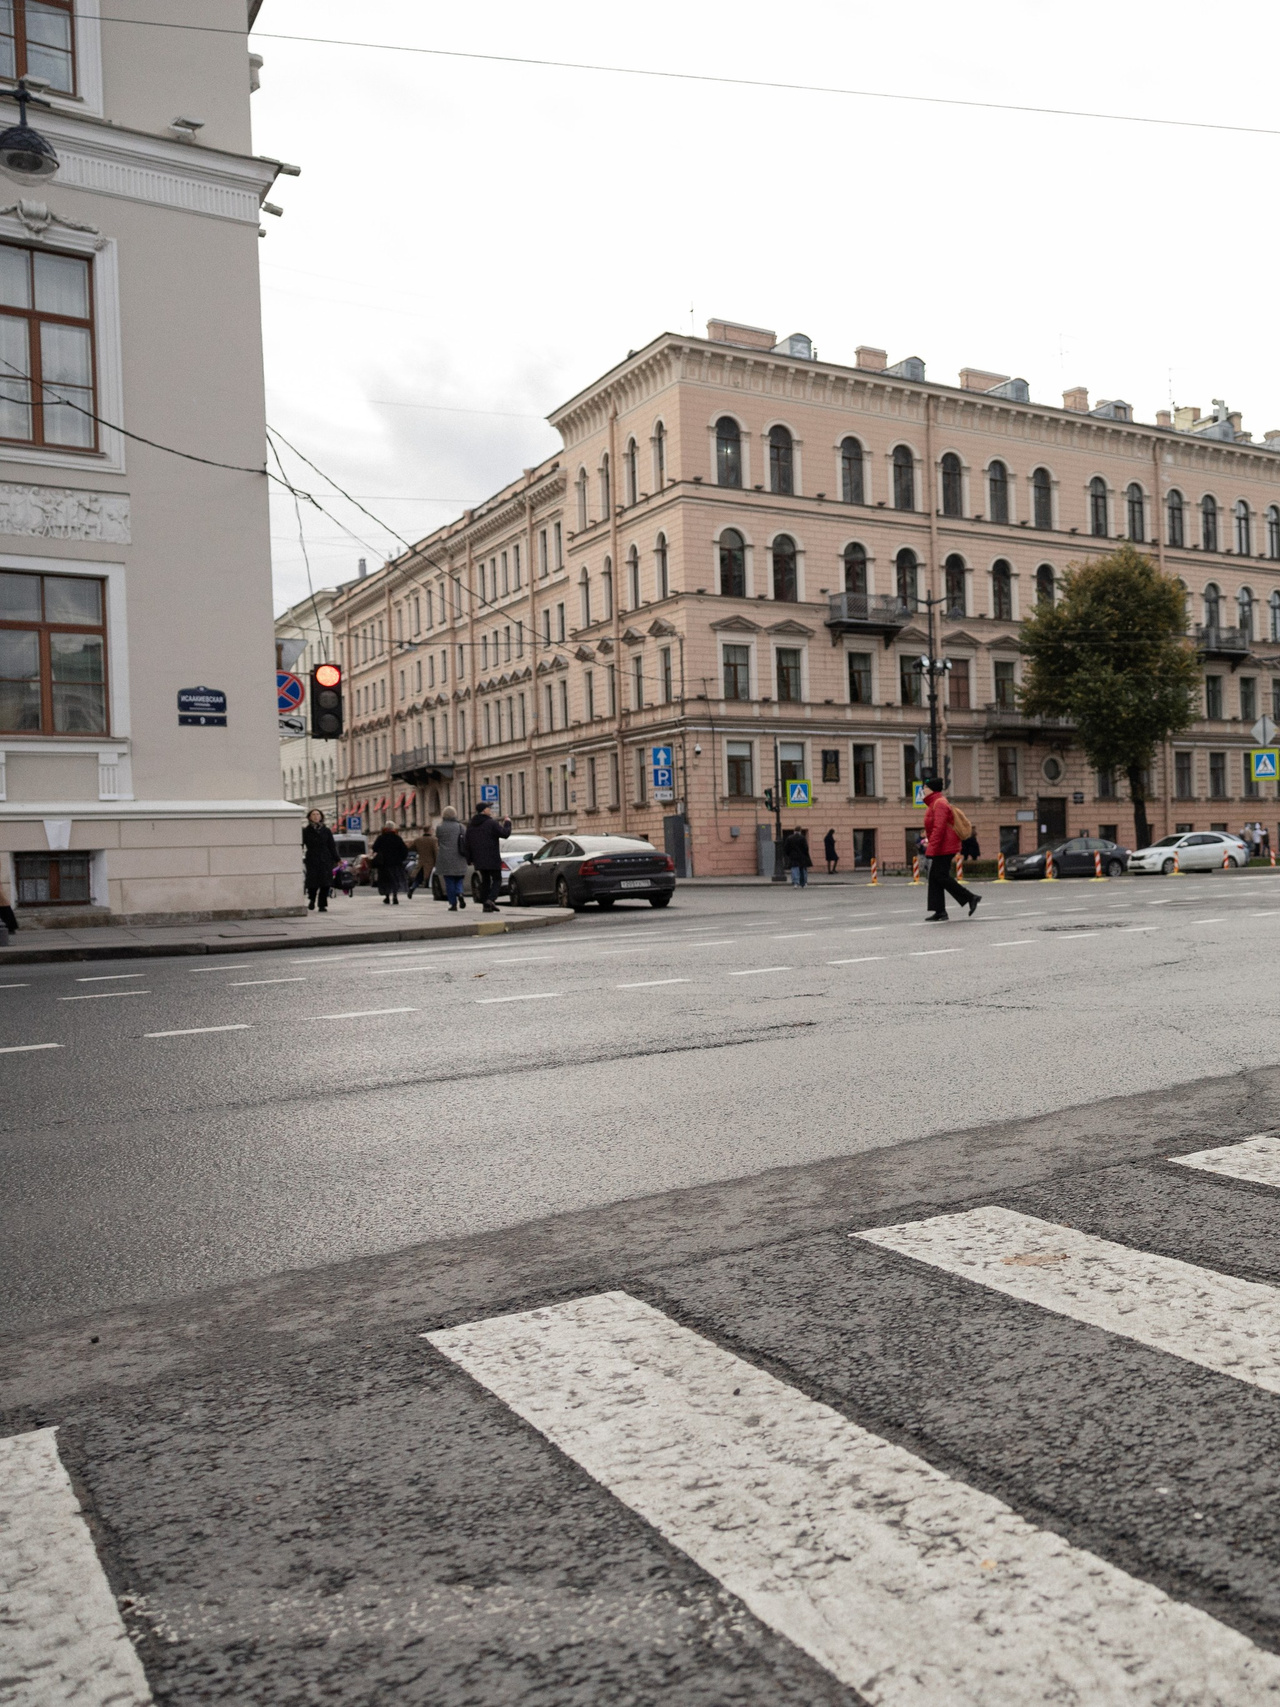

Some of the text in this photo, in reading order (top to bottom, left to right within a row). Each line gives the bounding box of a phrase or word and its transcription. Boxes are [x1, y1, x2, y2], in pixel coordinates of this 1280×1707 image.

[181, 695, 224, 703] ИСААКИЕВСКАЯ
[200, 716, 206, 725] 9
[658, 770, 669, 785] P
[485, 786, 496, 800] P
[351, 817, 360, 828] P
